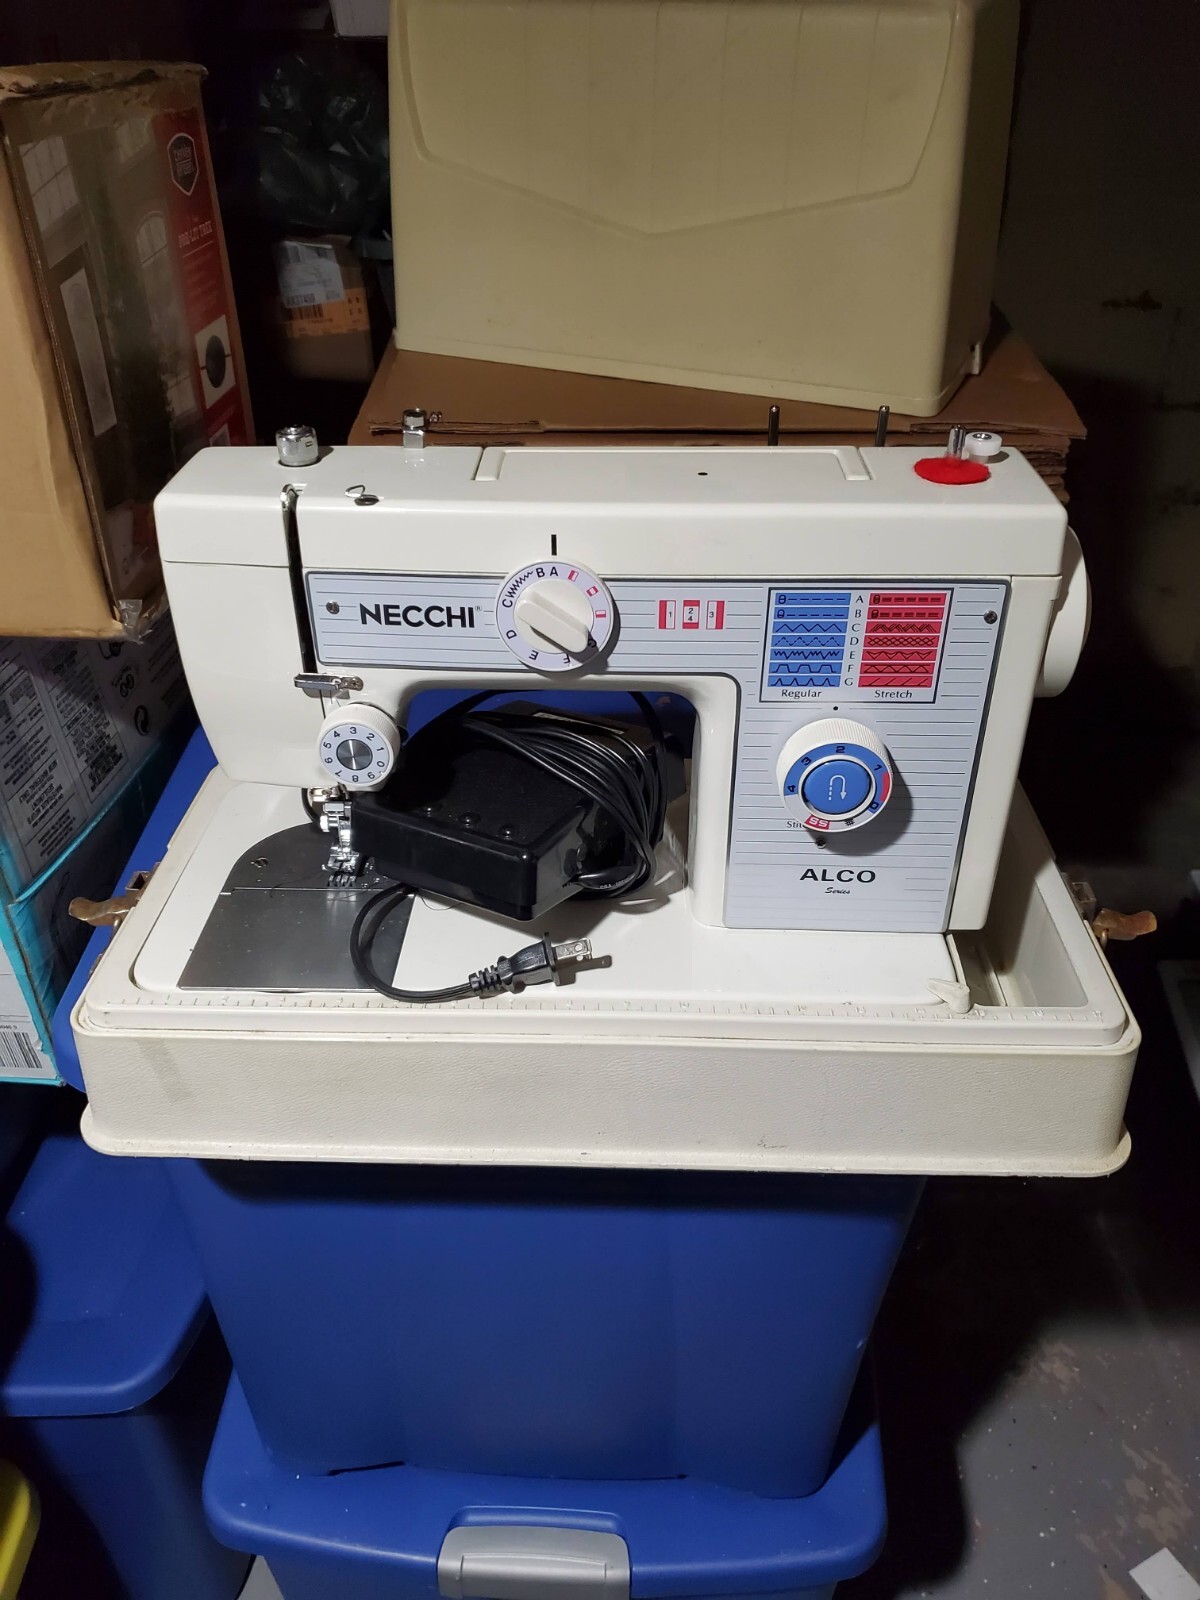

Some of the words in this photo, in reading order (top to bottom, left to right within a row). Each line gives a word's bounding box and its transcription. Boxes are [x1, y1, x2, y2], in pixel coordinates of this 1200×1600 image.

[536, 567, 546, 578] B
[549, 566, 559, 577] A
[502, 598, 513, 608] C
[855, 595, 864, 604] A
[359, 602, 475, 629] NECCHI
[688, 607, 694, 615] 2
[854, 609, 862, 618] B
[851, 623, 861, 632] C
[506, 629, 517, 640] D
[849, 636, 859, 646] D
[529, 649, 539, 661] E
[849, 651, 856, 660] E
[847, 664, 854, 673] F
[844, 677, 854, 686] G
[781, 689, 822, 699] Regular
[874, 689, 913, 699] Stretch
[333, 730, 341, 738] 4
[349, 726, 357, 735] 3
[366, 733, 375, 741] 2
[835, 745, 846, 754] 2
[801, 756, 812, 766] 3
[873, 764, 882, 772] 1
[352, 774, 359, 783] 8
[787, 784, 796, 793] 4
[799, 868, 876, 883] ALCO
[824, 886, 851, 895] Series
